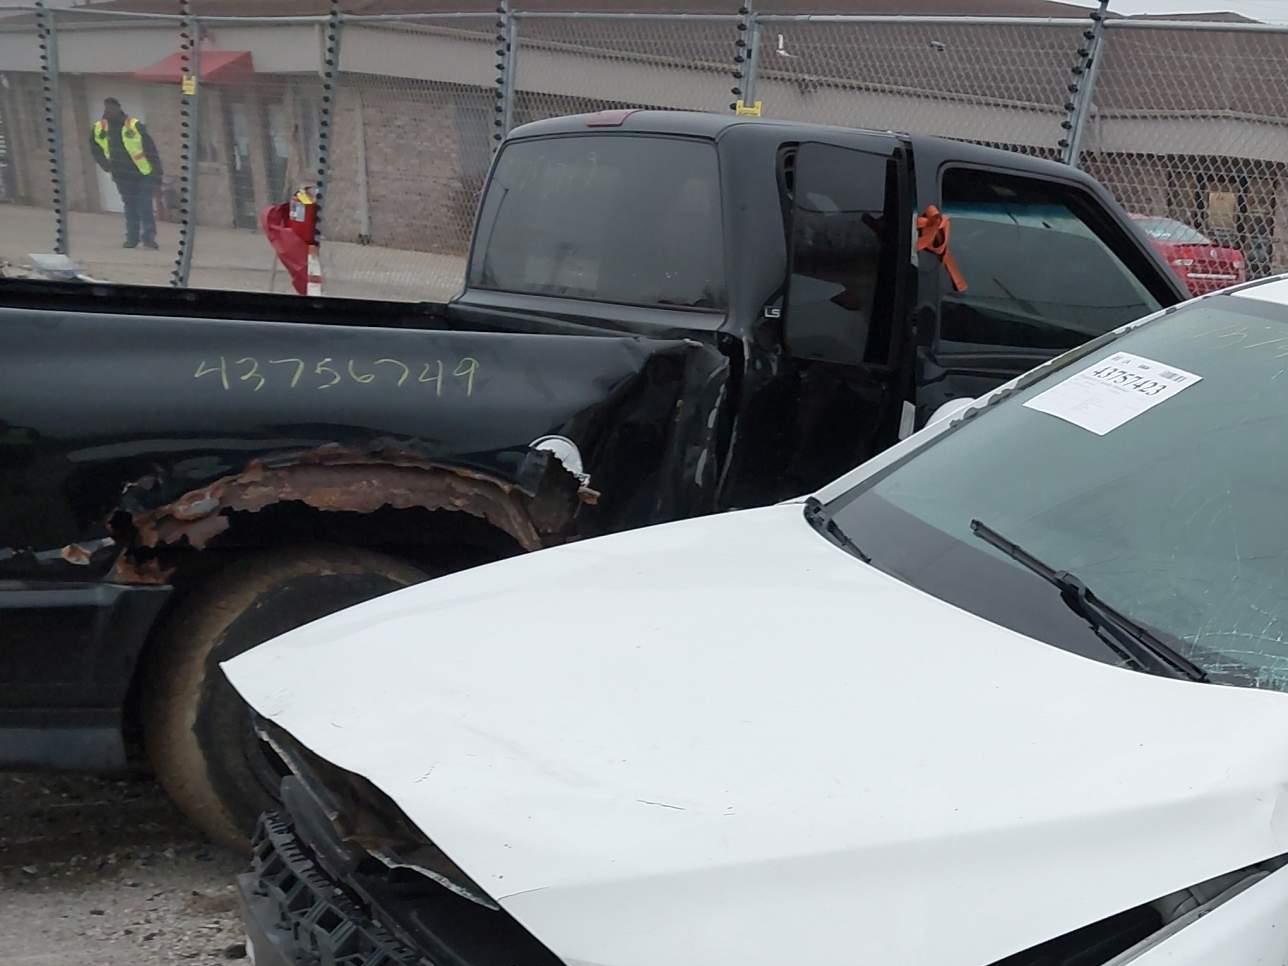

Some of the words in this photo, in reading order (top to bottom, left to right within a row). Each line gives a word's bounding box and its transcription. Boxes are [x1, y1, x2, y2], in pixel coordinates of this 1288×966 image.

[764, 306, 781, 318] LS
[194, 356, 480, 397] 43756749
[1092, 366, 1167, 397] 43757423
